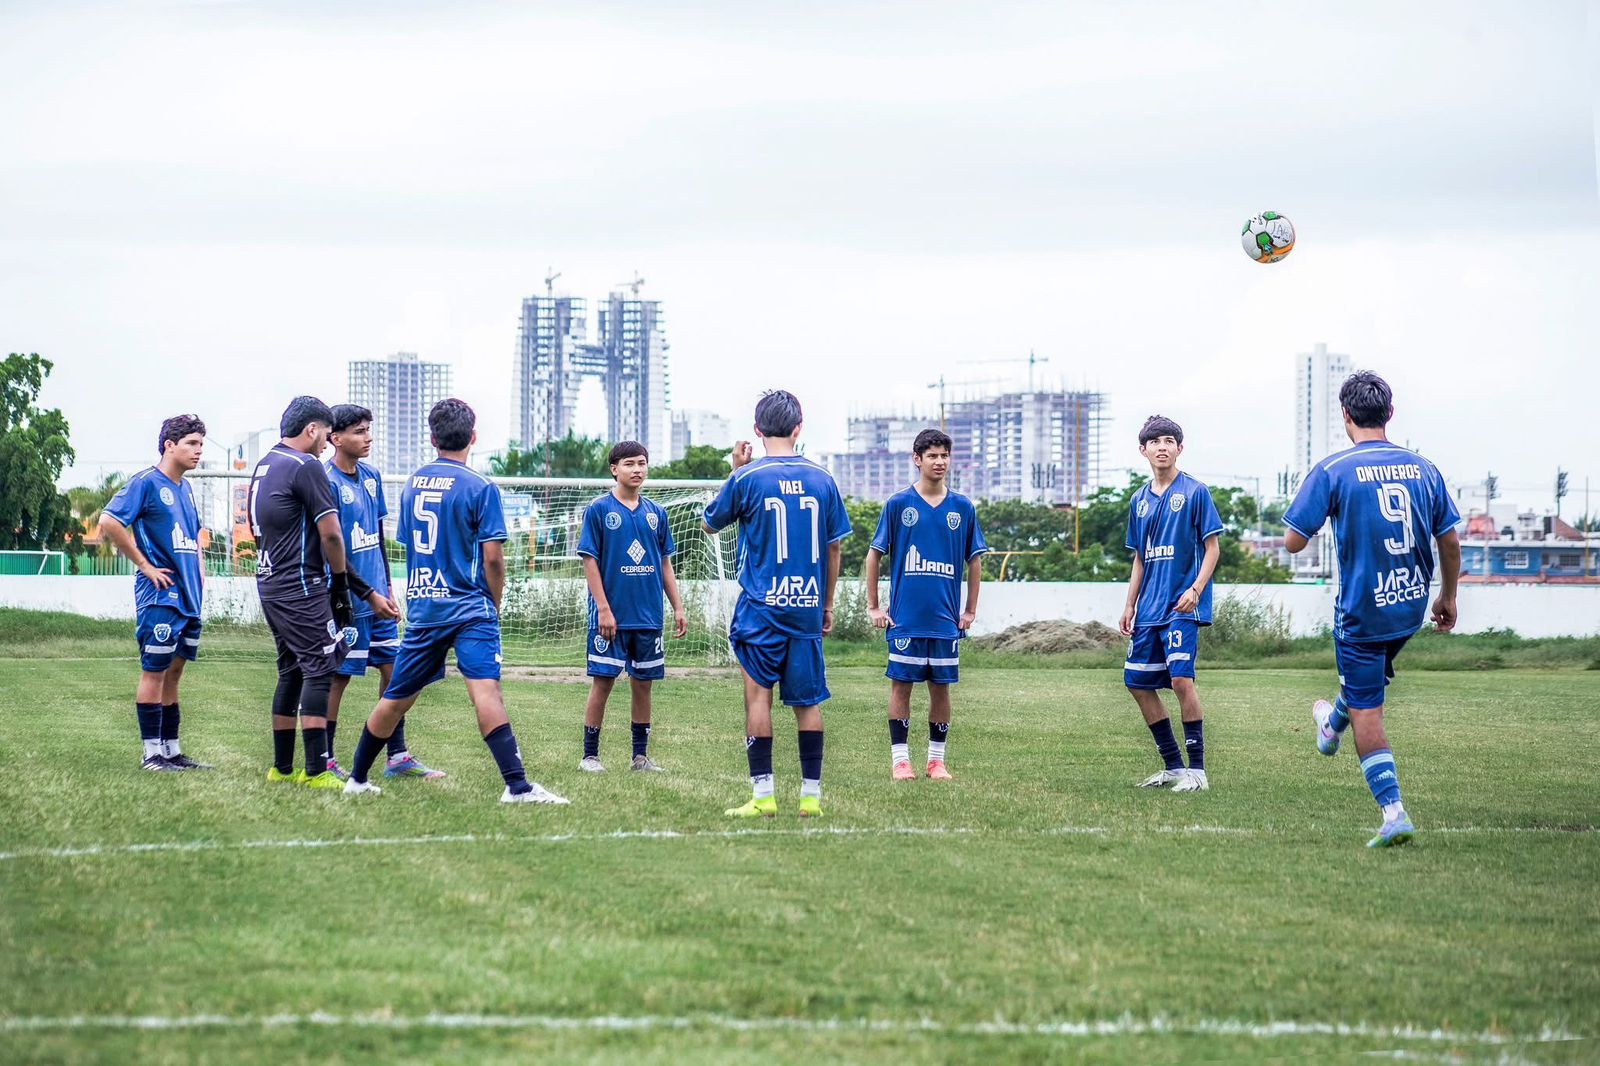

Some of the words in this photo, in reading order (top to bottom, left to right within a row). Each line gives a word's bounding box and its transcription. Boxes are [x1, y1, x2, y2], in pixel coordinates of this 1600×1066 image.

[1356, 464, 1421, 482] ONTIVEROS
[412, 476, 455, 490] VELARDE
[779, 480, 805, 494] VAEL
[413, 491, 442, 554] 5
[1376, 483, 1415, 555] 9
[766, 576, 819, 595] JARA
[1373, 565, 1425, 593] JARA
[407, 586, 451, 600] SOCCER
[765, 595, 819, 607] SOCCER
[1375, 584, 1427, 608] SOCCER
